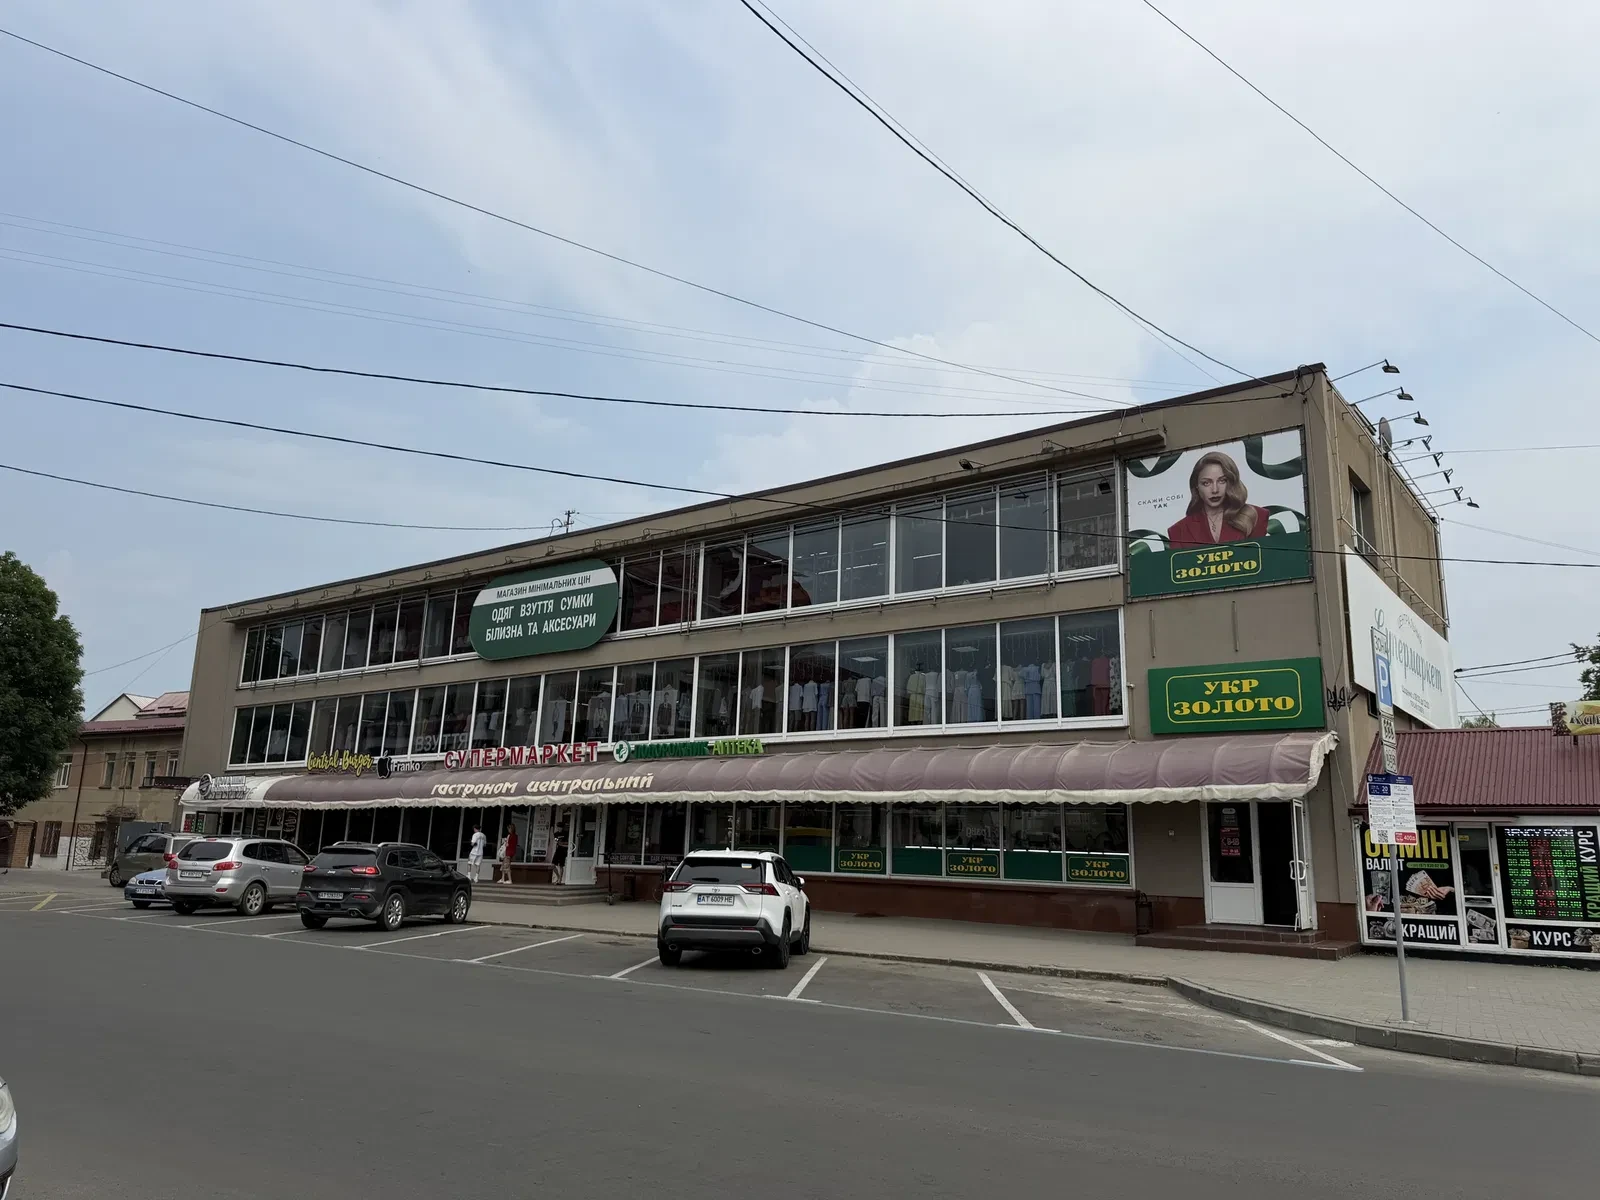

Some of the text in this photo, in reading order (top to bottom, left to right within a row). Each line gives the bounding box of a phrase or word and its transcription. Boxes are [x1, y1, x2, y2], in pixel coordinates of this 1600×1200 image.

[1137, 497, 1163, 506] СКАЖИ
[1196, 550, 1234, 564] УКР
[1175, 560, 1258, 579] ЗОЛОТО
[496, 574, 592, 599] МАГАЗИН МІНІМАЛЬНИХ ЦІН
[491, 593, 594, 624] ОДЯГ ВЗУТТЯ СУМКИ
[485, 613, 597, 642] БІЛИЗНА ТА АКСЕСУАРИ
[1203, 679, 1259, 696] УКР
[1173, 696, 1295, 716] ЗОЛОТО
[415, 732, 469, 751] ВЗУТТЯ
[712, 738, 764, 756] АПТЕКА
[307, 749, 374, 777] Central Burger
[444, 741, 601, 770] СУПЕРМАРКЕТ
[390, 761, 421, 772] iFranko
[431, 772, 655, 798] гастроном центральний
[840, 859, 881, 868] ЗОЛОТО
[850, 852, 870, 861] УКР
[961, 856, 983, 865] УКР
[1085, 860, 1110, 869] УКР
[950, 863, 997, 873] ЗОЛОТО
[1071, 868, 1125, 879] ЗОЛОТО
[1577, 830, 1600, 919] КРАЩИЙ КУРС
[711, 895, 723, 903] 6009
[1401, 924, 1457, 941] КРАЩИЙ
[1532, 930, 1572, 947] КУРС
